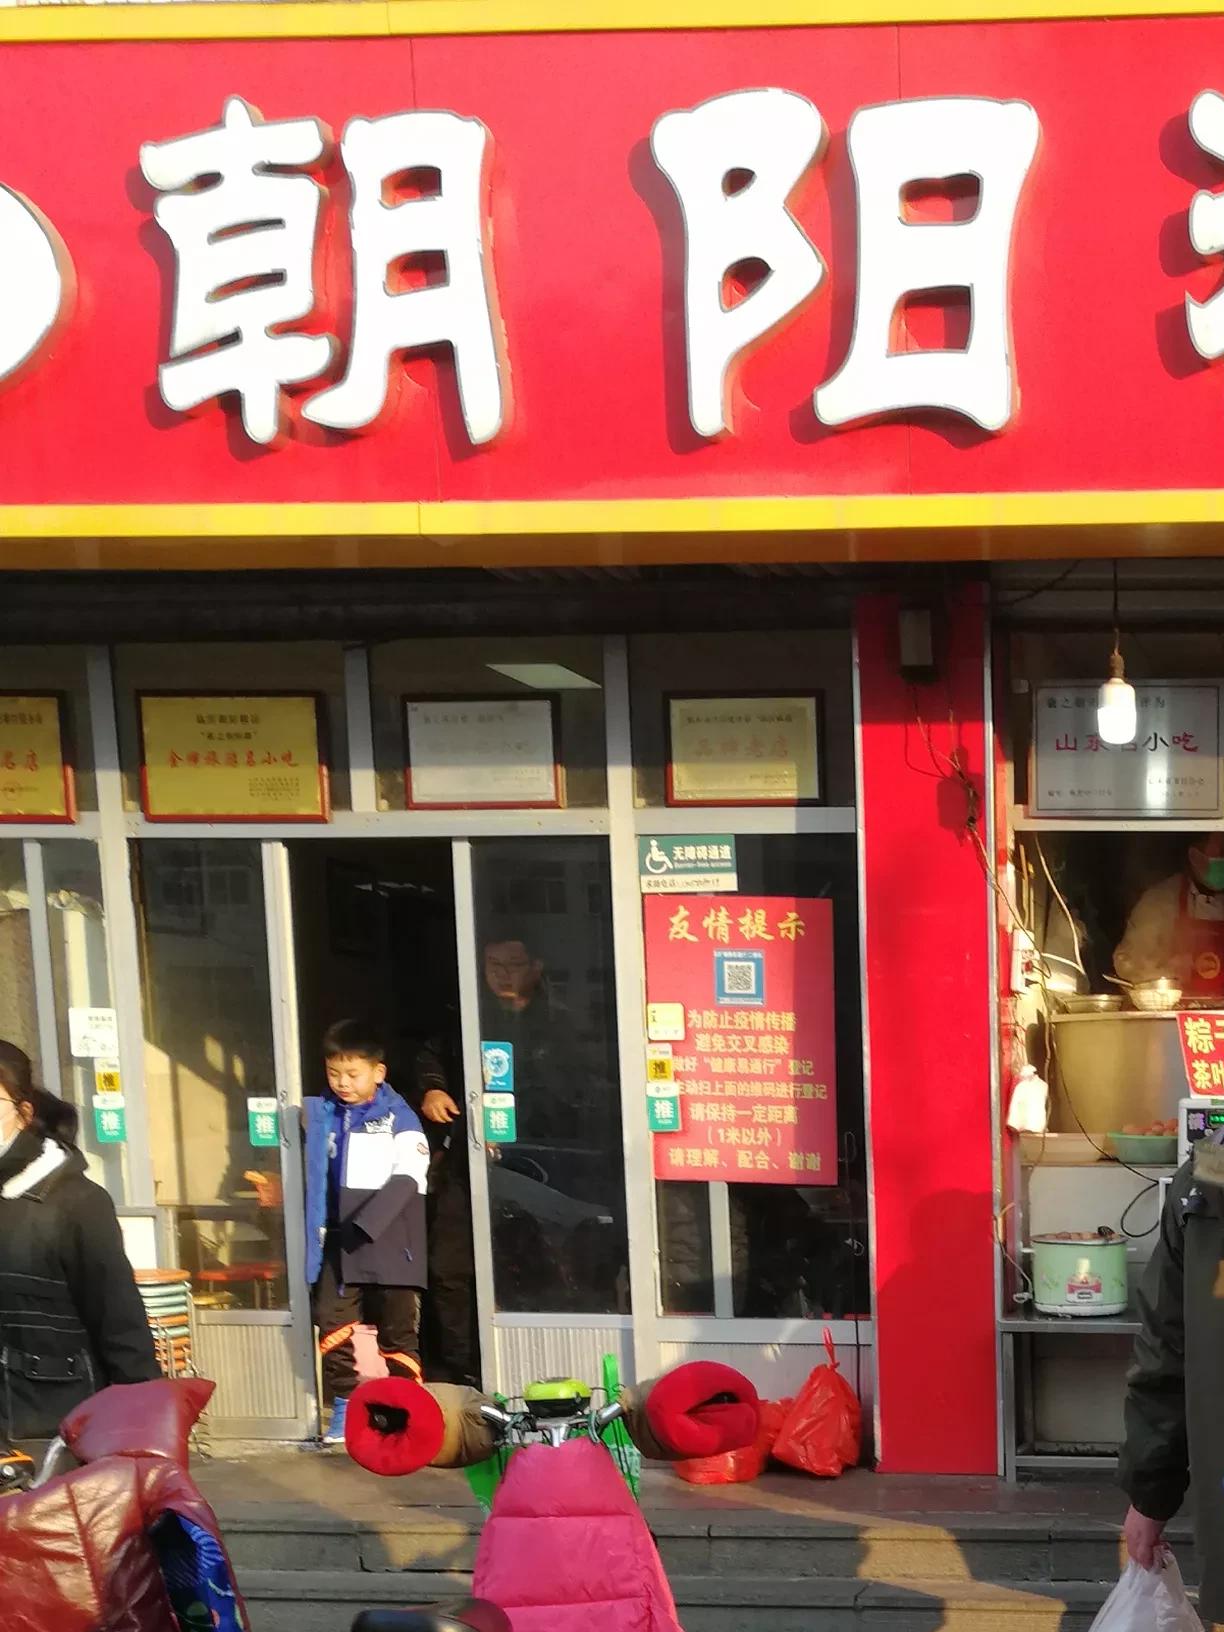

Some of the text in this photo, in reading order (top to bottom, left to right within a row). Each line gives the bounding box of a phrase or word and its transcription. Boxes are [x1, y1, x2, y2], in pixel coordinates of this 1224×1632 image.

[1056, 732, 1199, 753] 山东小吃
[673, 845, 732, 861] 无障碍通道
[667, 904, 807, 944] 友情提示
[686, 1009, 797, 1032] 为防止疫情传播
[689, 1103, 799, 1124] 请保持一定距离
